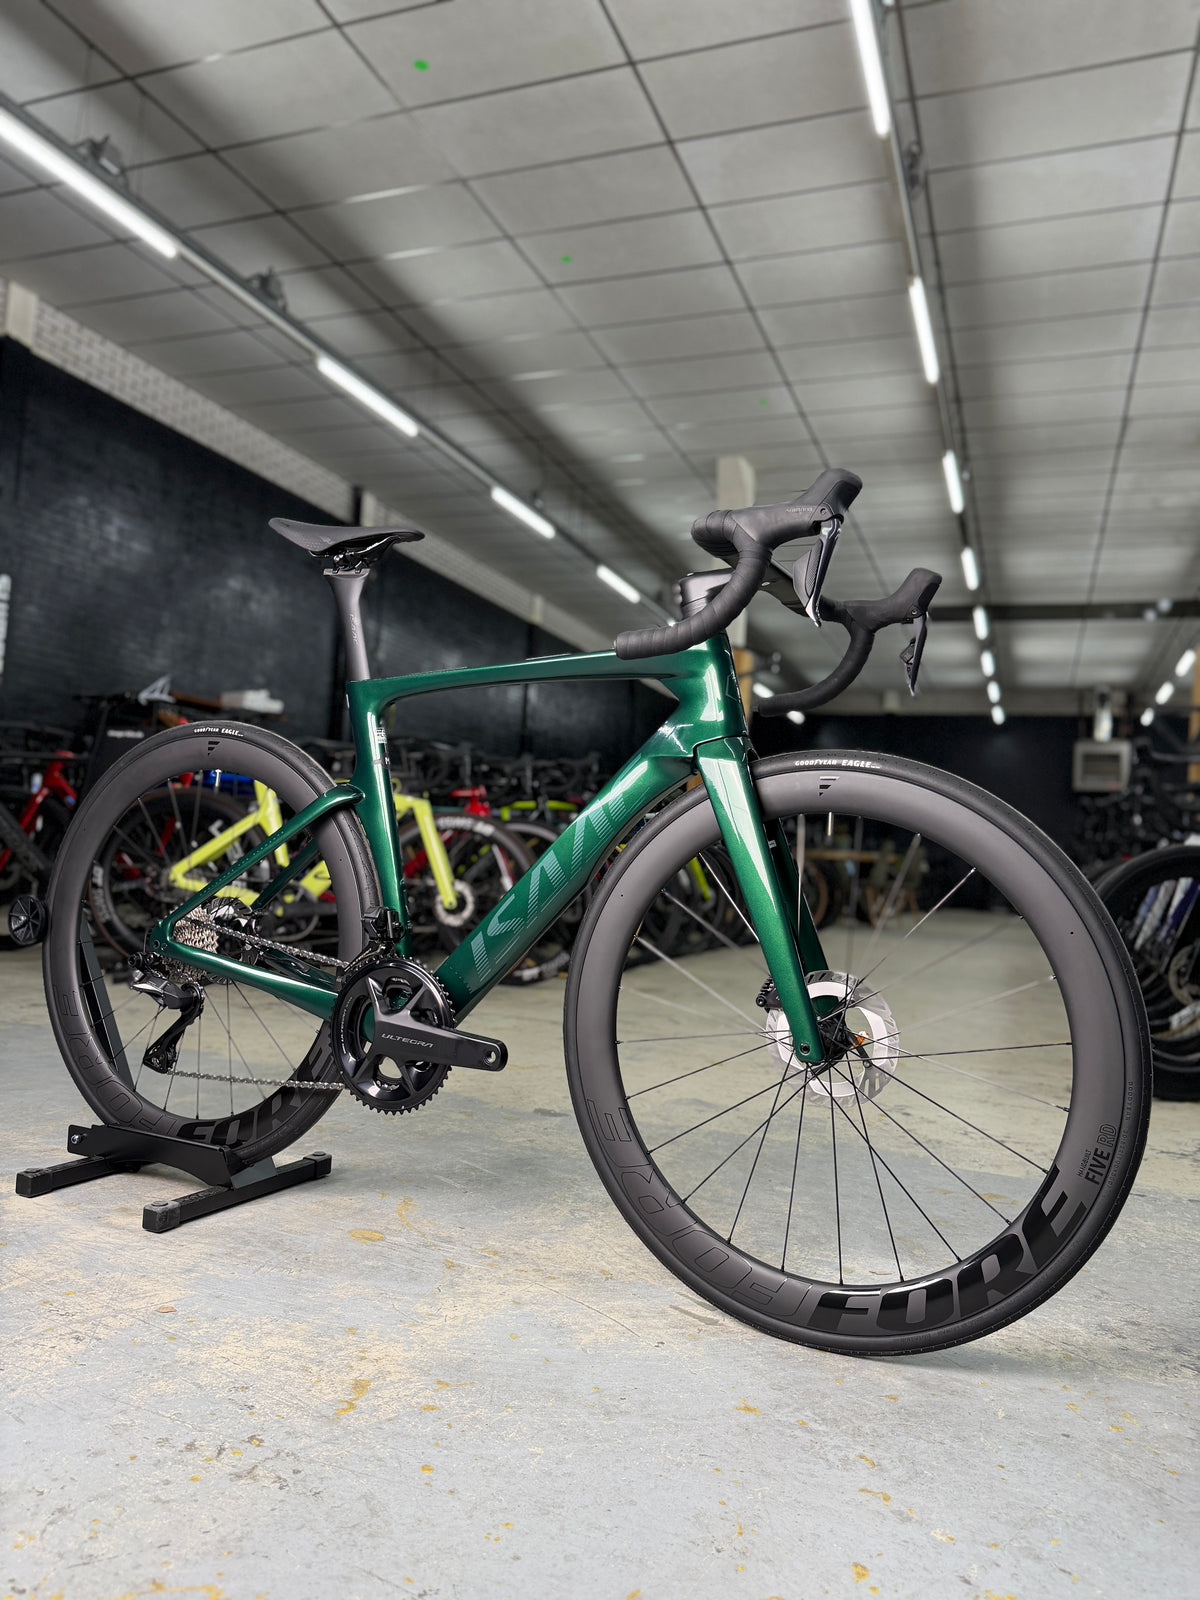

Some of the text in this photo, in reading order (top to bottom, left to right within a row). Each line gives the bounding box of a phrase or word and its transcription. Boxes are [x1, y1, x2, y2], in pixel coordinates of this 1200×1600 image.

[221, 728, 239, 736] EAGLE
[841, 759, 872, 769] EAGLE
[381, 1033, 434, 1049] ULTEGRA
[1084, 1123, 1117, 1185] FIVE RD
[587, 1099, 813, 1317] FORE
[805, 1163, 1087, 1332] FORE
